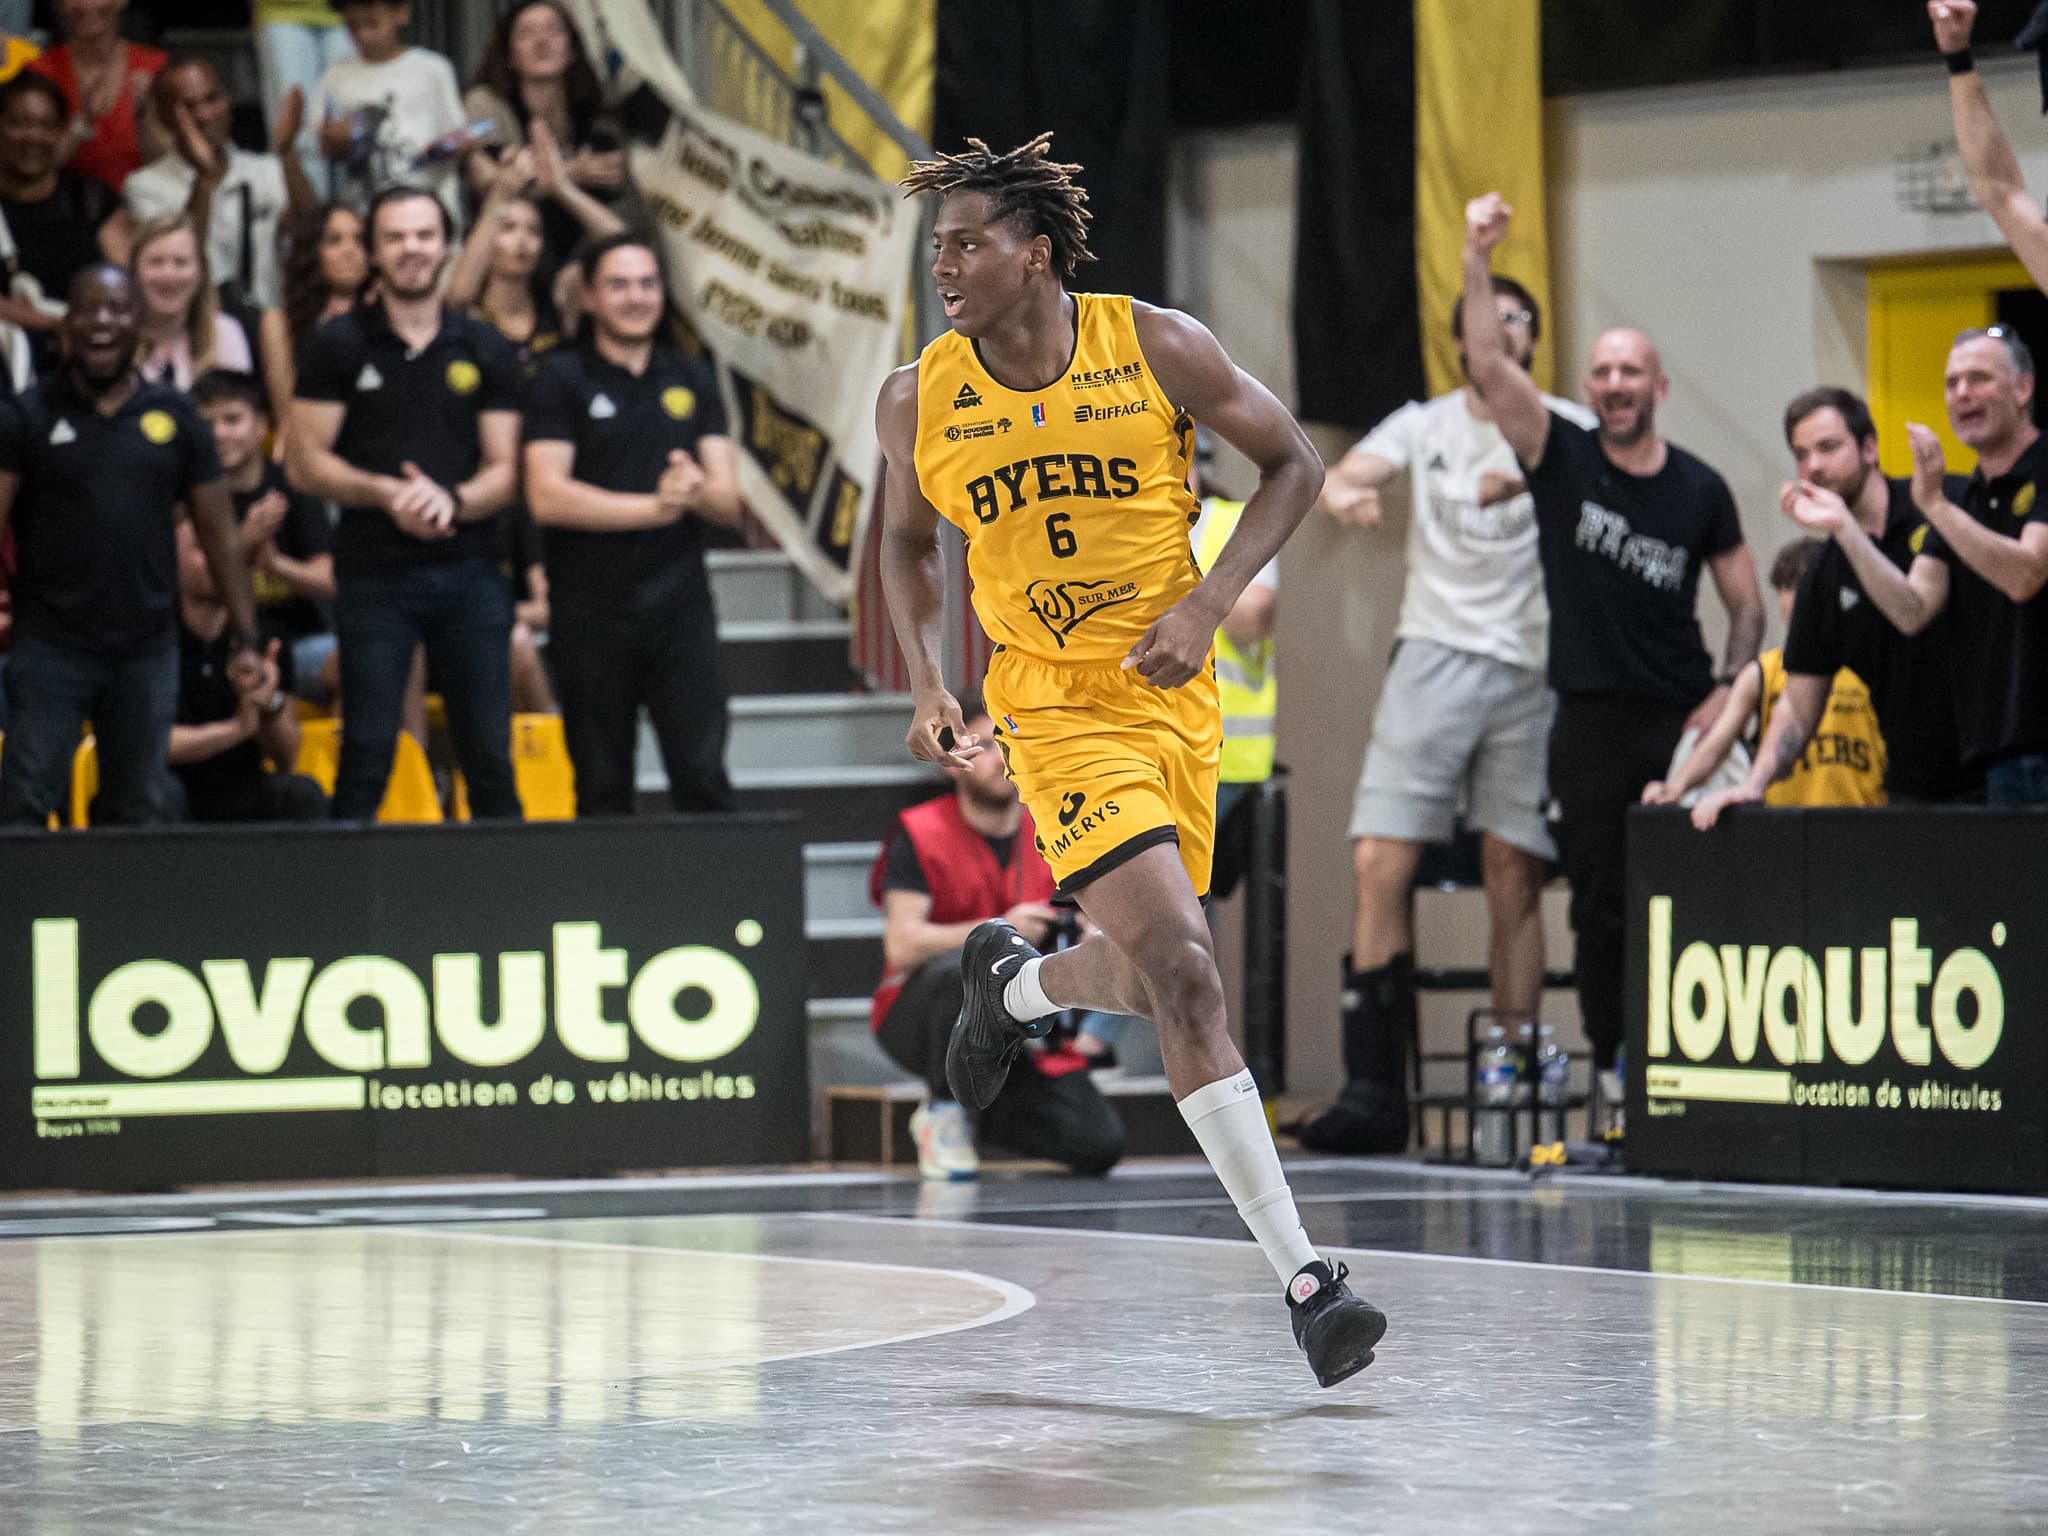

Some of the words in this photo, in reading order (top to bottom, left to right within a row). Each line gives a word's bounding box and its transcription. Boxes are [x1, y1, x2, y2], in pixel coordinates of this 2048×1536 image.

[1071, 361, 1141, 383] HECTARE
[953, 395, 983, 410] PEAK
[1095, 399, 1149, 421] EIFFAGE
[1045, 512, 1078, 559] 6
[1078, 593, 1107, 605] SUR
[1107, 582, 1137, 600] MER
[1051, 800, 1120, 858] IMERYS
[32, 918, 760, 1079] lovauto
[1647, 895, 2005, 1070] lovauto
[369, 1078, 518, 1109] location
[529, 1074, 575, 1105] de
[587, 1069, 756, 1103] véhicules
